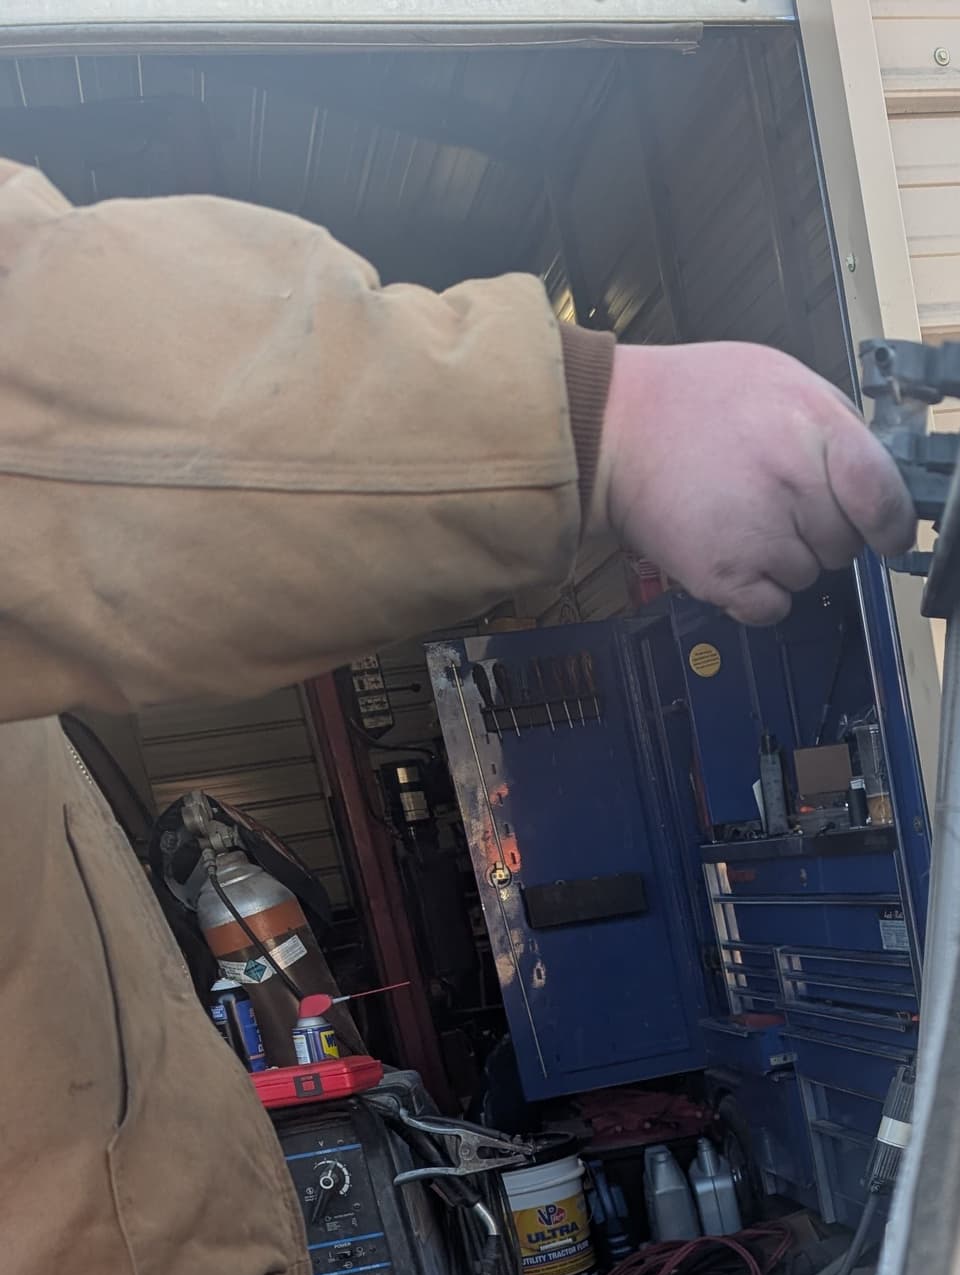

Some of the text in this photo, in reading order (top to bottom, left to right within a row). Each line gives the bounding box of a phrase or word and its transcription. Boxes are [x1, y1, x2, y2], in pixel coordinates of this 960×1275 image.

[537, 1204, 557, 1226] VP
[527, 1222, 580, 1243] ULTRA
[548, 1246, 577, 1261] TRACTOR
